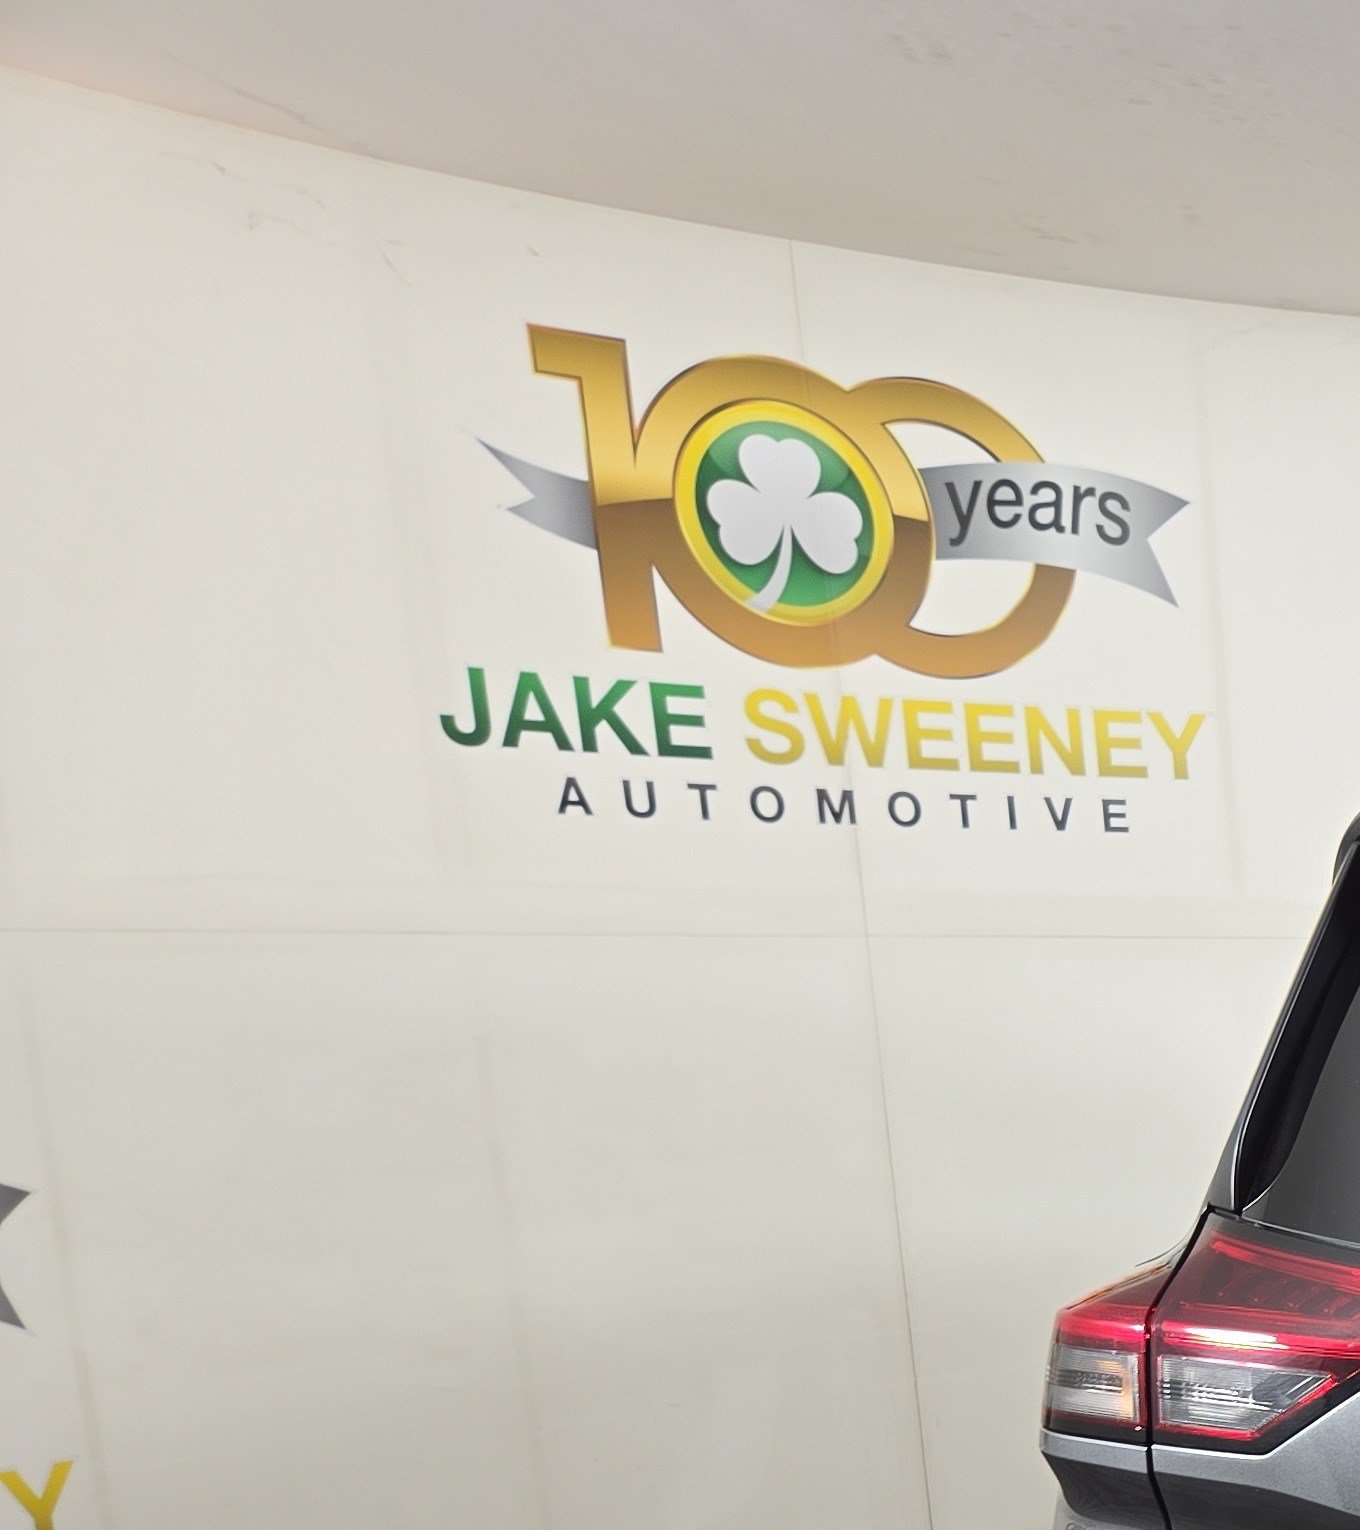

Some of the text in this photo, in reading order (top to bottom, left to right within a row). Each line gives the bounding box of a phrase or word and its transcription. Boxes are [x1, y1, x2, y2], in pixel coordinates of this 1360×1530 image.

[944, 478, 1132, 546] years
[439, 666, 1207, 781] JAKE SWEENEY
[557, 776, 1130, 833] AUTOMOTIVE
